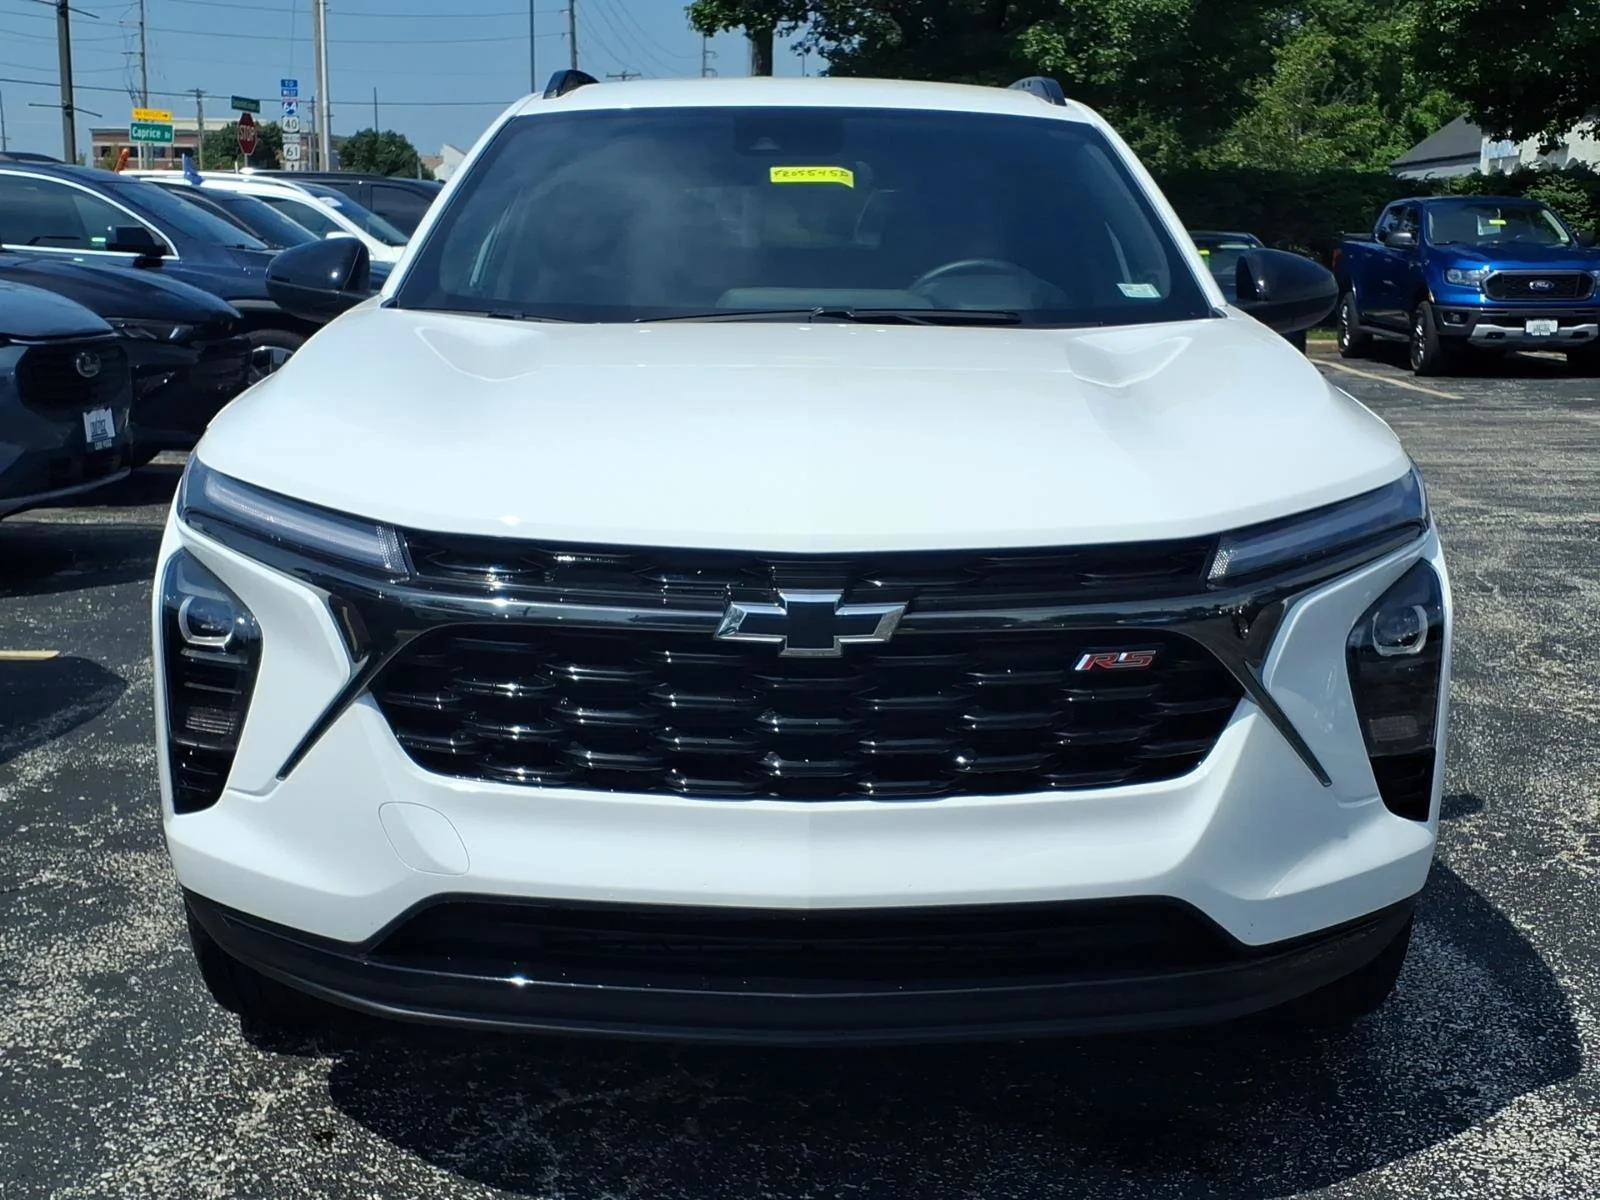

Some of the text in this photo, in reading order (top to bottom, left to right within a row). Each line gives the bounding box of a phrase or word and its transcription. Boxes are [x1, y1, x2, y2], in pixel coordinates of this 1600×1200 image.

[284, 119, 297, 130] 40
[132, 126, 161, 139] Caprice
[240, 124, 254, 141] STOP
[286, 146, 298, 157] 61
[1074, 649, 1156, 670] RS
